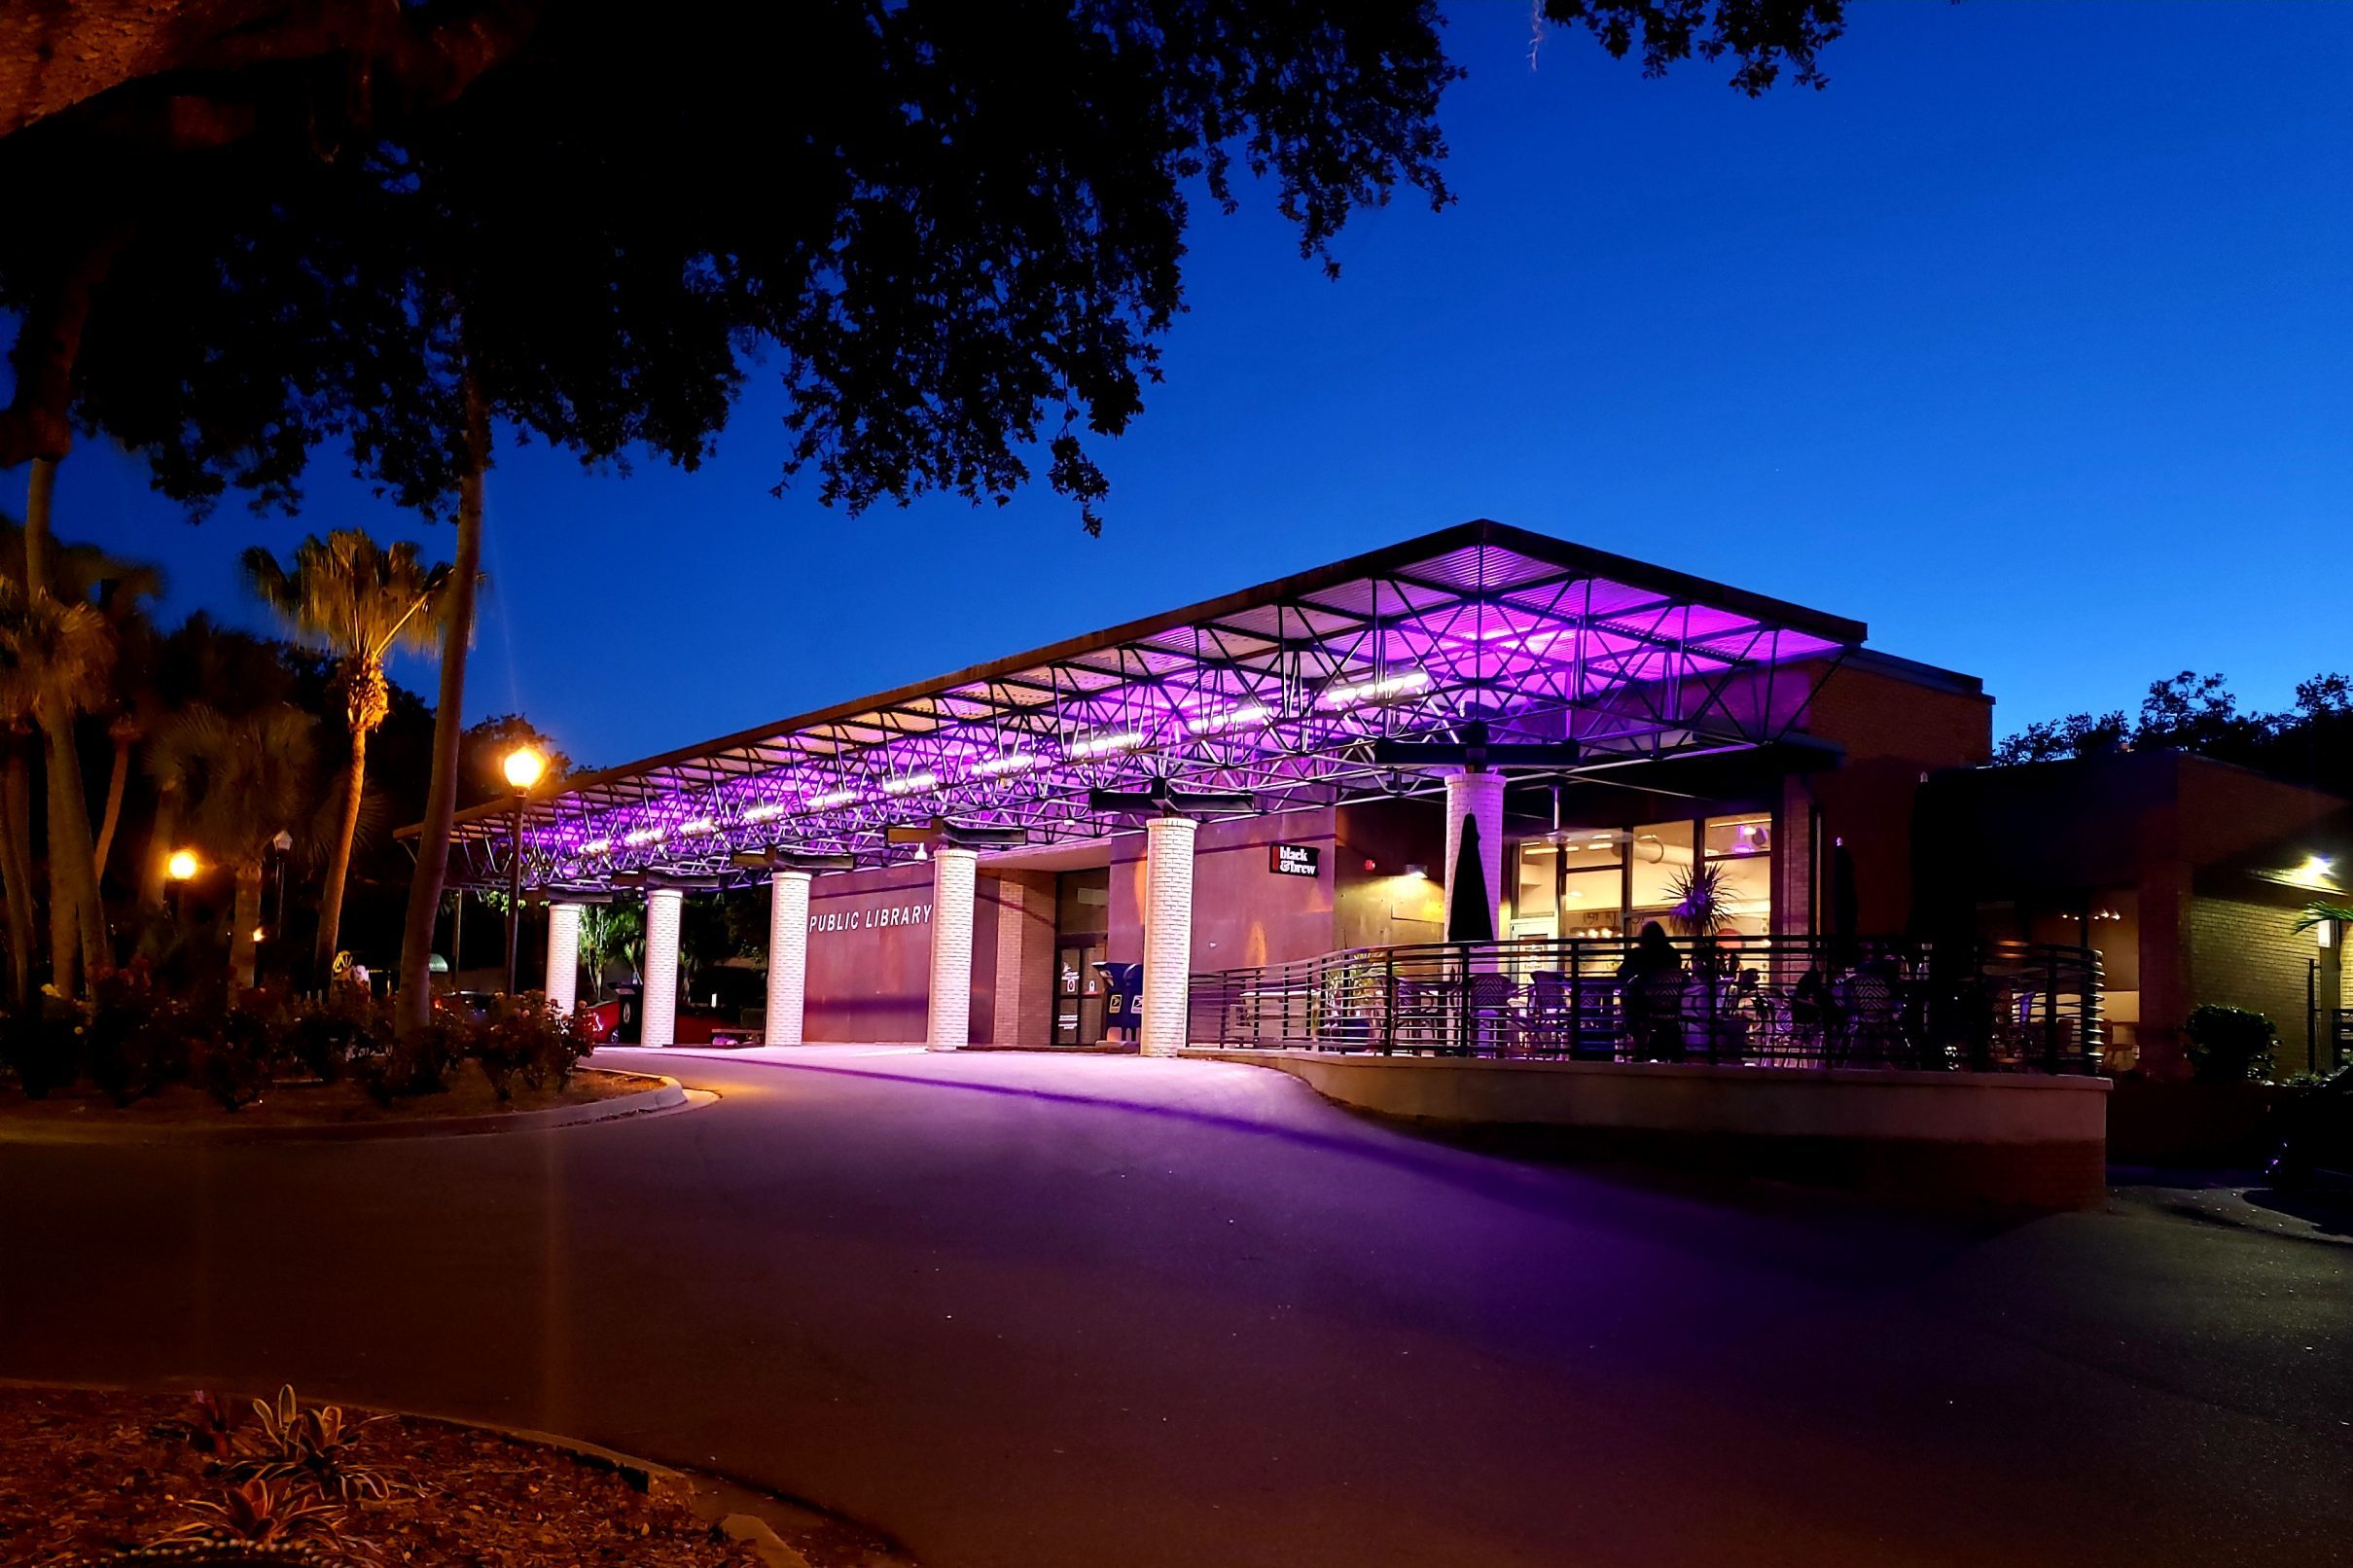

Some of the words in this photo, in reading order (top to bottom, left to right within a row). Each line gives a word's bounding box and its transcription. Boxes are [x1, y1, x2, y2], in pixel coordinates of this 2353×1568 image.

[1280, 846, 1307, 861] black
[808, 911, 859, 933] PUBLIC
[865, 905, 933, 928] LIBRARY
